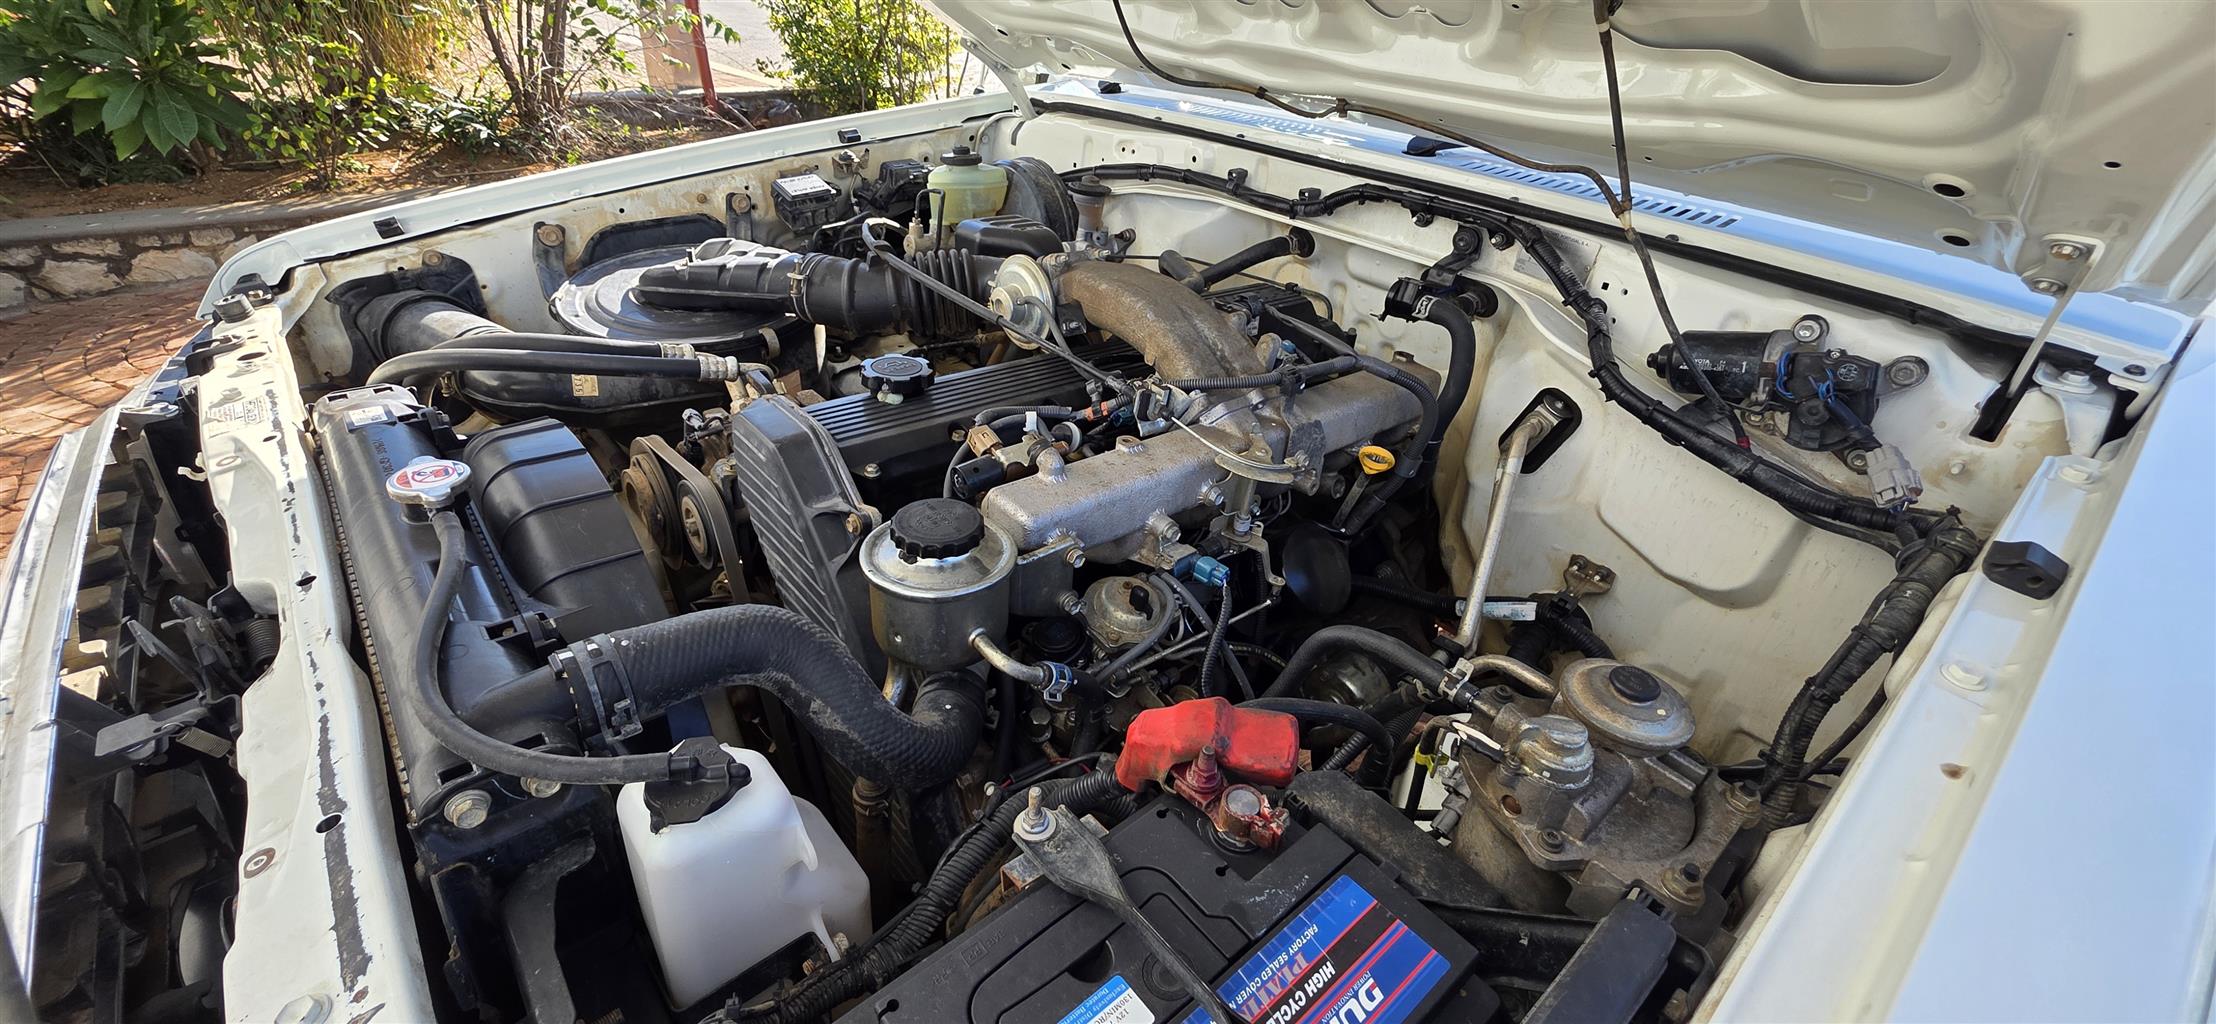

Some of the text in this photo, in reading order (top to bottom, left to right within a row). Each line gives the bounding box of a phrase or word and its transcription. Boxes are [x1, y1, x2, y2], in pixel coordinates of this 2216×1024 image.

[1288, 923, 1319, 956] FACTORY
[1261, 952, 1289, 981] SEALED
[1303, 961, 1336, 998] HIGH
[1352, 970, 1372, 992] POWER
[1092, 983, 1127, 1012] Exclusively
[1235, 977, 1262, 1004] COVER
[1237, 952, 1310, 1022] PLATIN
[1115, 1008, 1129, 1021] 12V
